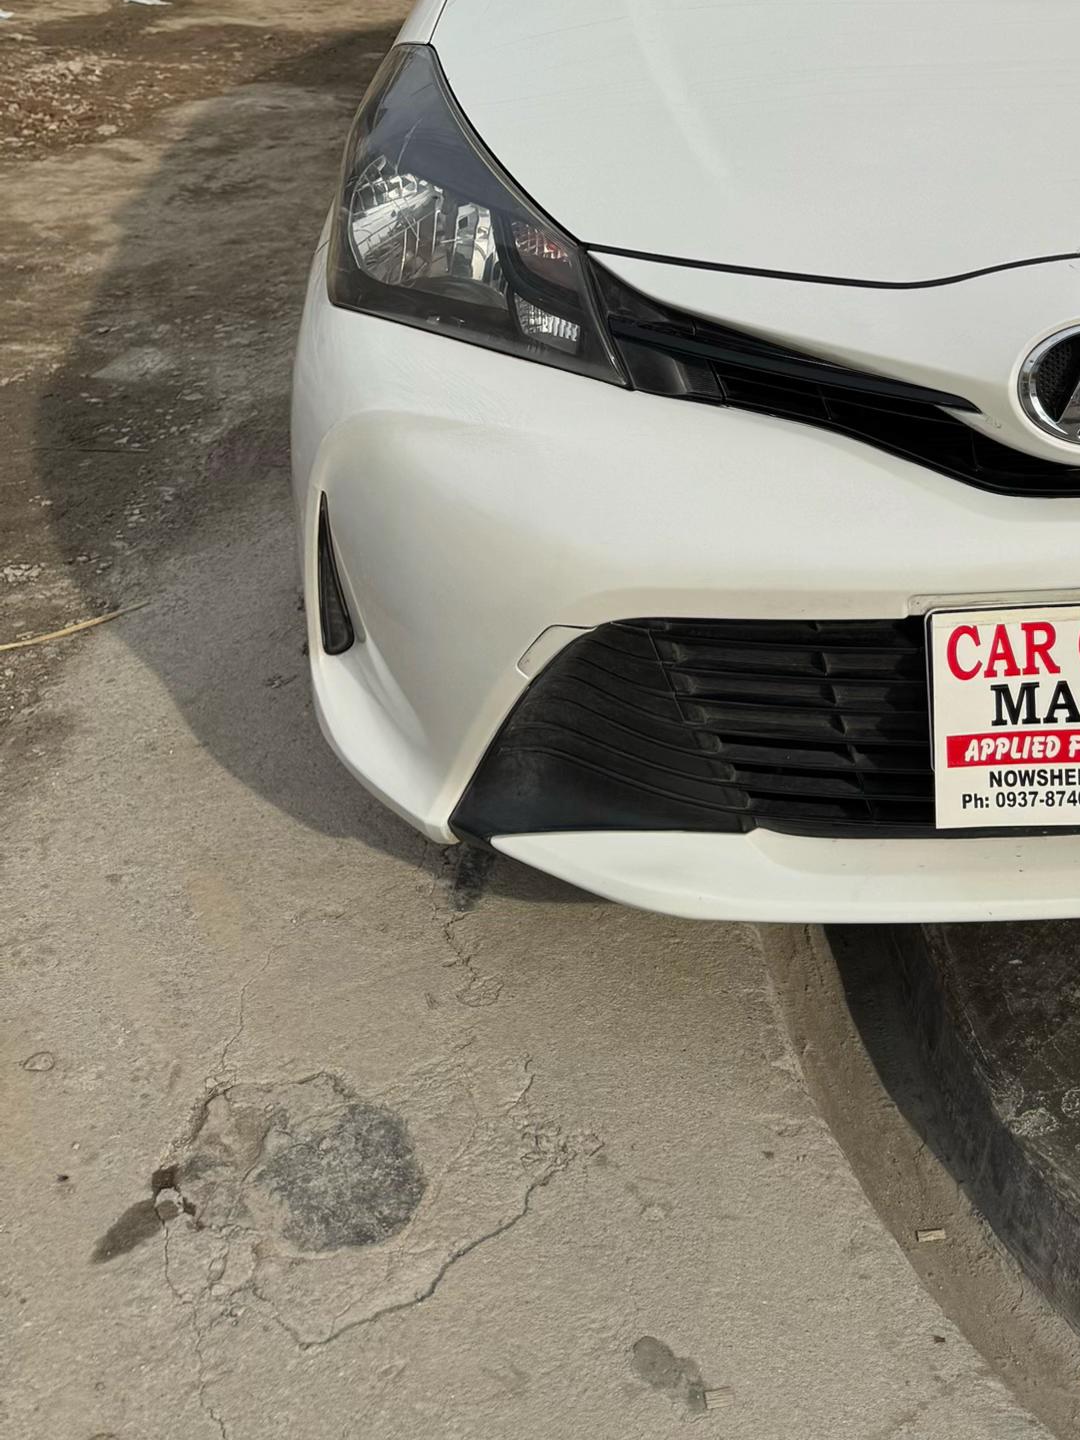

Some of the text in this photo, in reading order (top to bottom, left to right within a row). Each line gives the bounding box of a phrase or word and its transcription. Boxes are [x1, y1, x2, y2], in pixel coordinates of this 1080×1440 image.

[946, 620, 1061, 681] CAR
[964, 734, 1062, 762] APPLIED
[961, 793, 990, 810] Ph:
